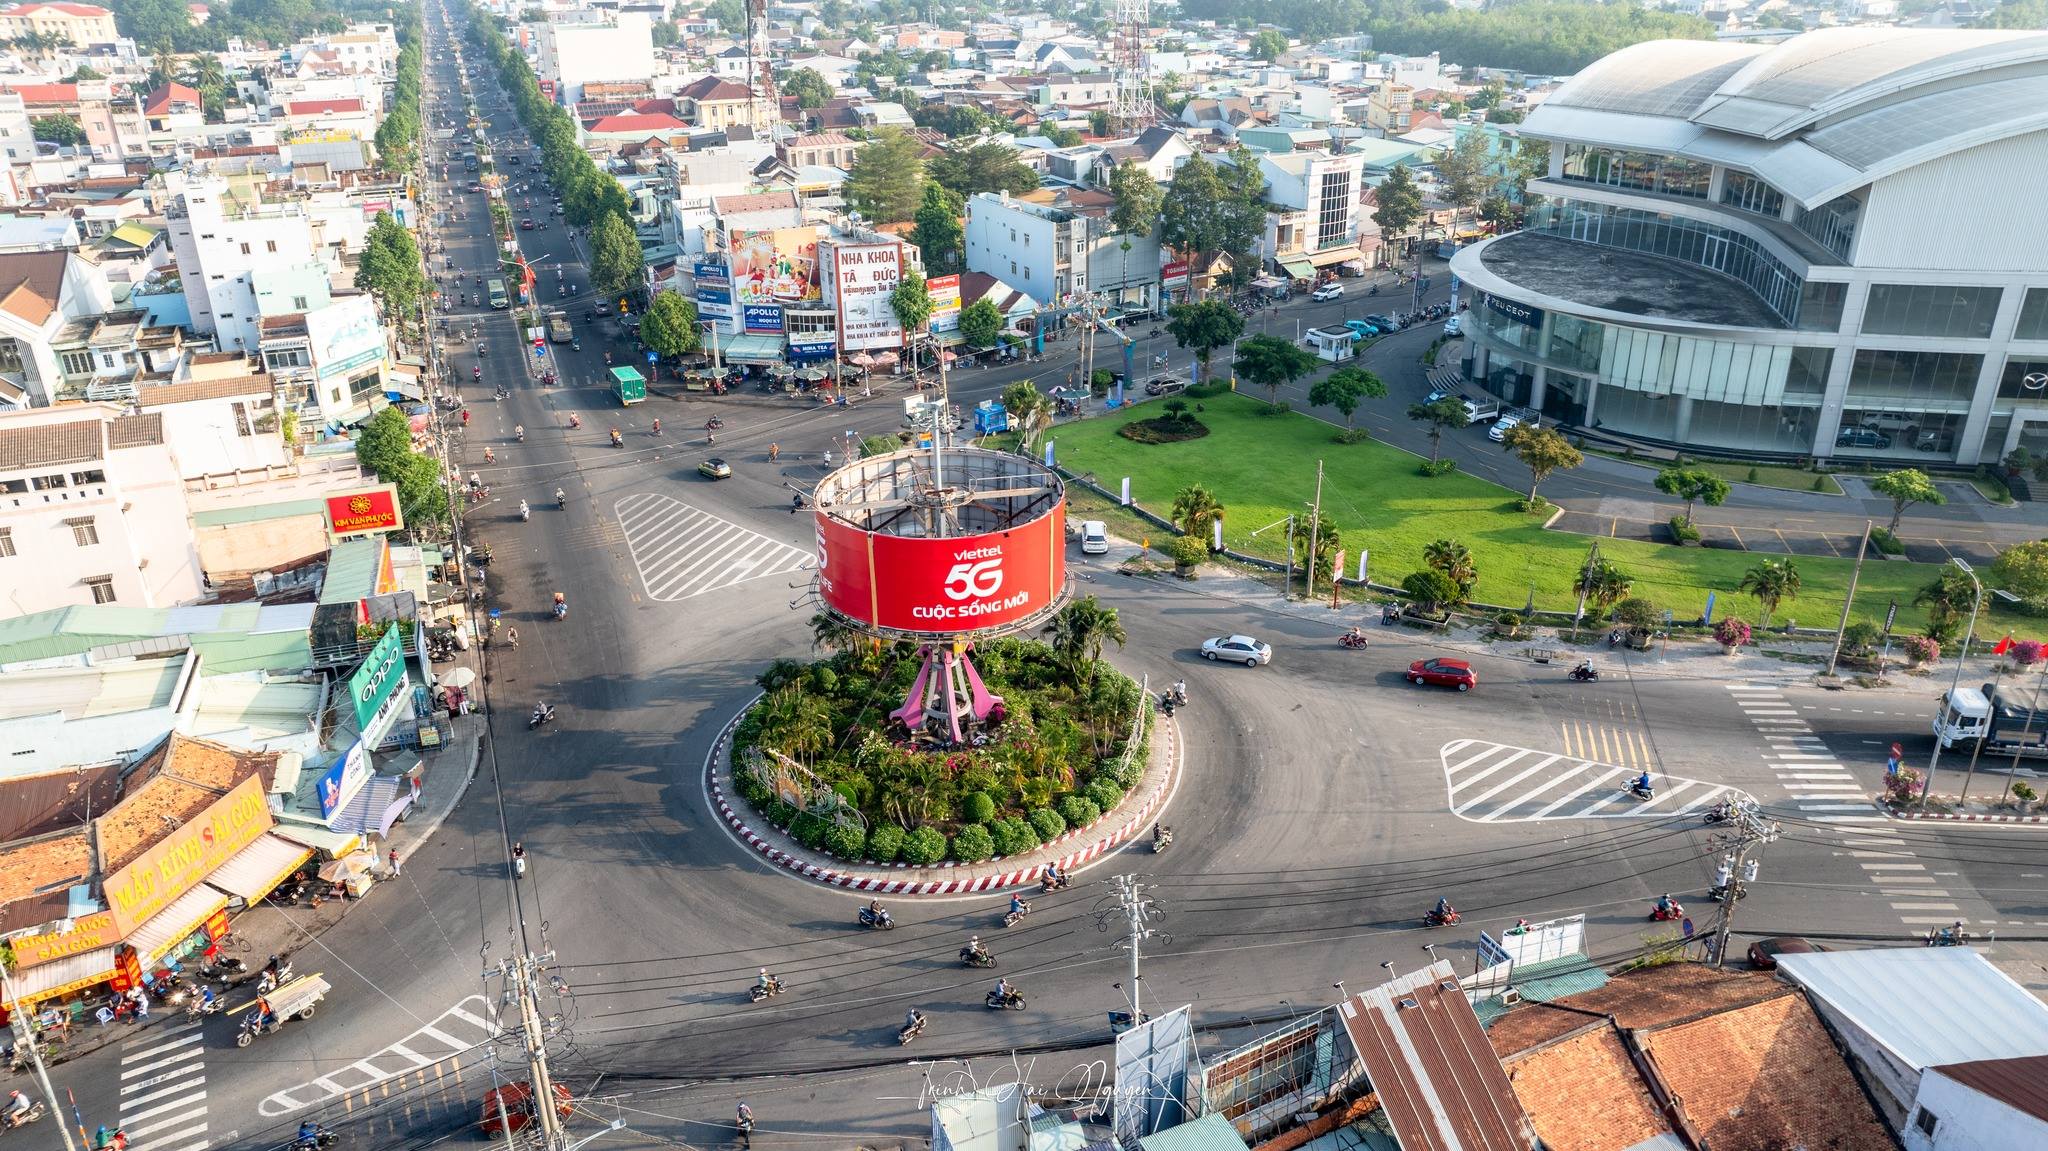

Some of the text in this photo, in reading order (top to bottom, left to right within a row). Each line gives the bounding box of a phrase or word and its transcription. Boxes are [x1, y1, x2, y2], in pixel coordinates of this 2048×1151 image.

[841, 250, 895, 265] NHA KHOA
[873, 267, 896, 281] ĐỨC
[746, 308, 779, 316] APOLLO
[1491, 298, 1531, 318] PEUGEOT
[335, 519, 349, 527] KIM
[954, 545, 1003, 561] viettel
[944, 558, 1003, 600] 5G
[912, 590, 1029, 620] CUỘC SỐNG MỚI
